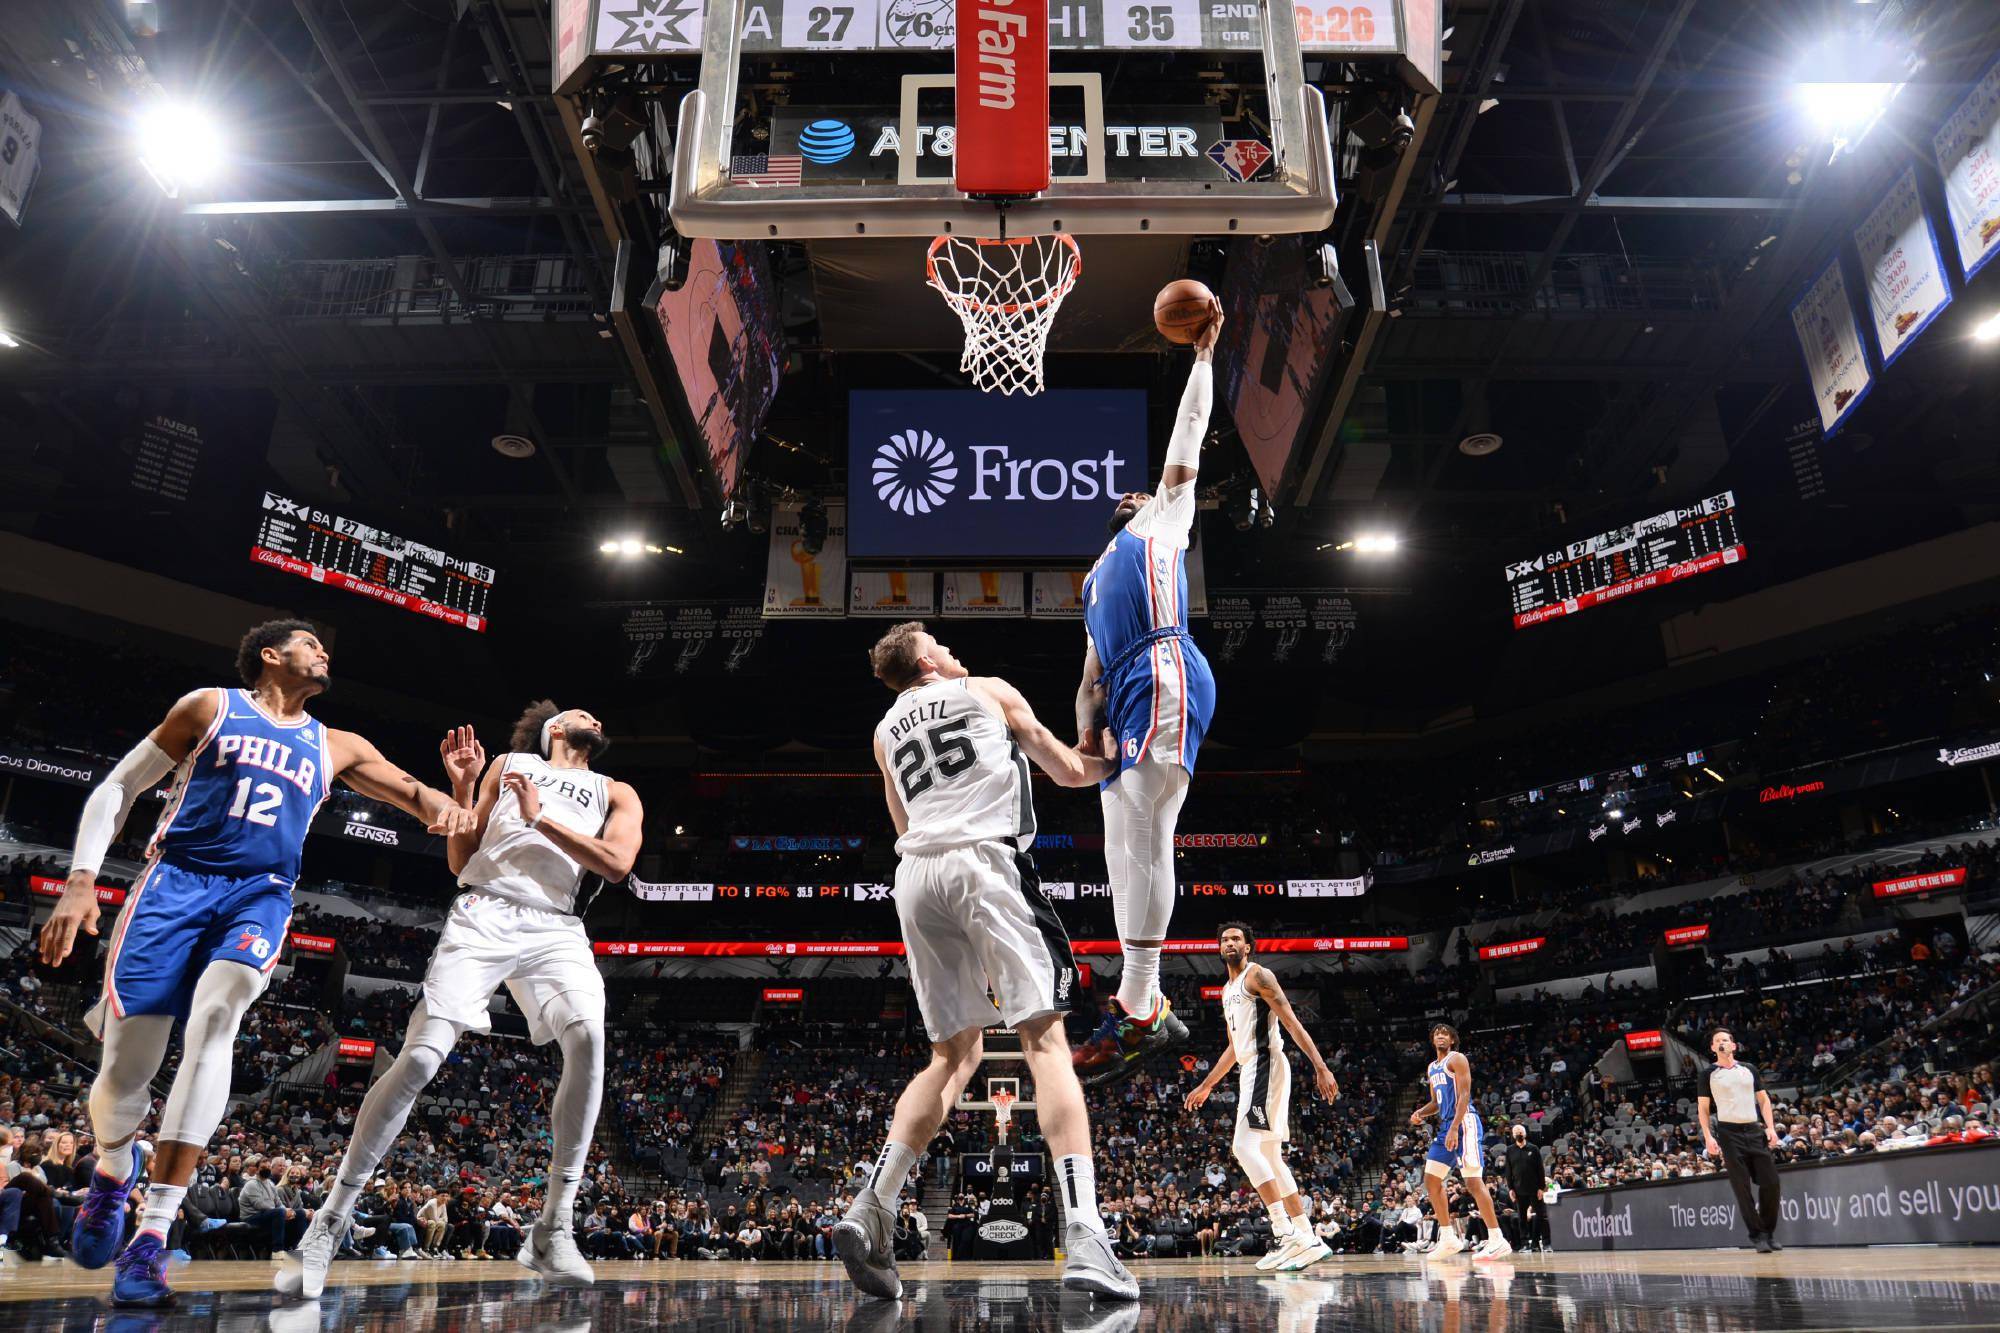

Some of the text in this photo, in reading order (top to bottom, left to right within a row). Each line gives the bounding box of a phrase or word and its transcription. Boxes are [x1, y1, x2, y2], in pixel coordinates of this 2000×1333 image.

[1211, 4, 1257, 18] 2ND
[807, 6, 854, 41] 27
[1049, 6, 1086, 38] HI
[1128, 5, 1174, 41] 35
[1222, 31, 1250, 41] QTR
[978, 9, 1027, 110] Farm
[869, 126, 1199, 157] AT& ENTER
[1244, 146, 1257, 160] 75
[968, 444, 1125, 501] Frost
[1710, 494, 1728, 512] 35
[312, 510, 330, 527] SA
[1677, 503, 1702, 521] PHI
[342, 519, 359, 536] 27
[1573, 541, 1588, 557] 27
[258, 551, 288, 569] Bally
[445, 556, 468, 573] PHI
[1547, 551, 1564, 565] SA
[474, 565, 490, 581] 35
[1671, 562, 1699, 578] Bally
[1607, 586, 1625, 599] HEART
[1212, 621, 1254, 629] 2007
[1264, 619, 1307, 628] 2013
[1314, 621, 1356, 630] 2014
[1520, 611, 1544, 625] Bally
[671, 631, 713, 639] 2003
[720, 630, 763, 638] 2005
[890, 700, 948, 741] POELTL
[215, 735, 316, 796] PHILA
[893, 715, 979, 804] 25
[26, 758, 92, 782] Diamond
[1760, 781, 1824, 803] Bally SPORTS
[228, 776, 284, 827] 12
[1036, 834, 1073, 848] ERVEZA
[1481, 844, 1516, 859] Firstmark
[42, 881, 54, 891] THE
[100, 890, 114, 900] FAN
[656, 884, 672, 892] AST
[674, 884, 690, 892] STL
[692, 884, 708, 892] BLK
[1080, 884, 1111, 897] PHI
[1192, 884, 1227, 896] FG%
[1254, 884, 1275, 896] TO
[1885, 873, 1955, 893] THE HEART OF THE FAN
[718, 886, 738, 898] TO
[756, 886, 790, 898] FG%
[820, 886, 840, 898] PF
[844, 886, 849, 898] 1
[235, 932, 271, 959] 76
[1488, 948, 1497, 957] THE
[1497, 946, 1512, 956] HEART
[1436, 1088, 1443, 1105] 0
[992, 1197, 1014, 1206] odoo
[1572, 1180, 2000, 1238] Orchard The easy to buy and sell you
[989, 1231, 1017, 1239] CHECK
